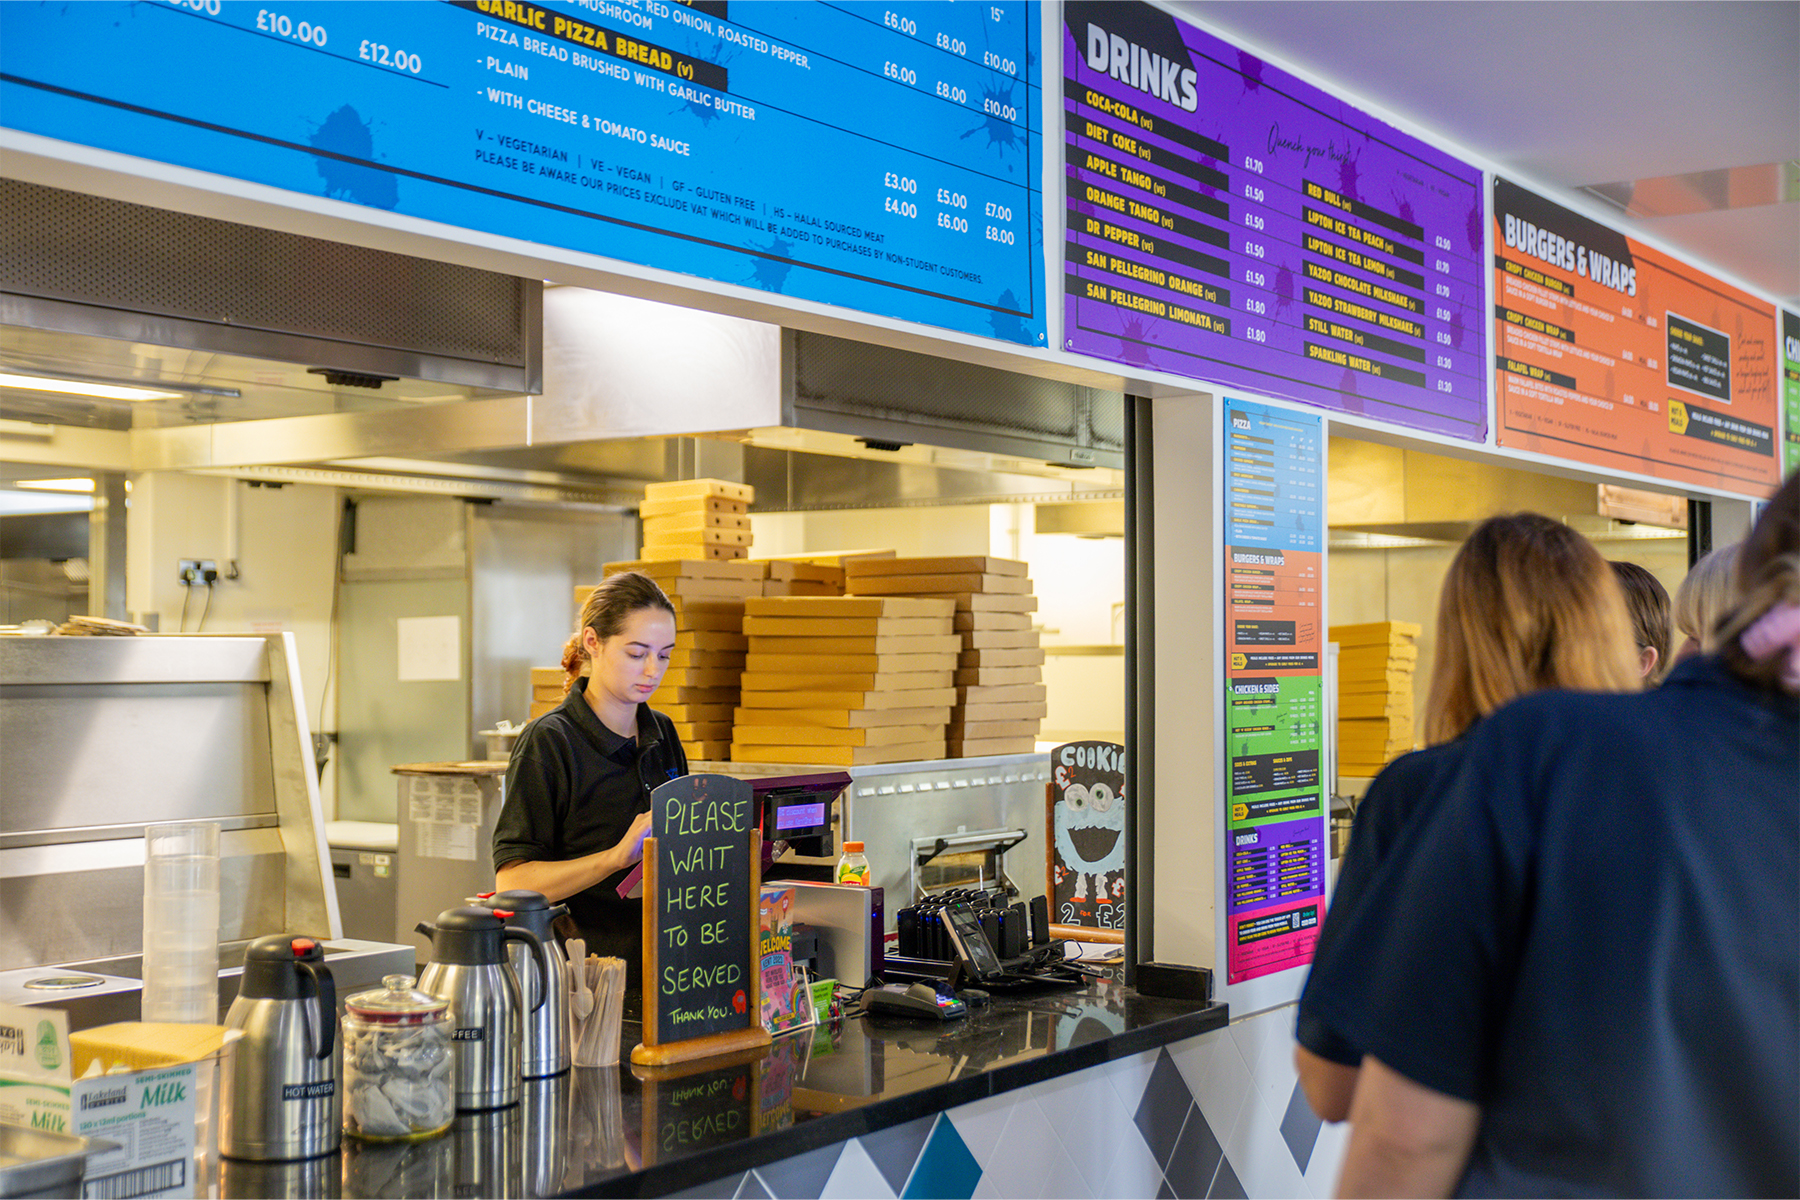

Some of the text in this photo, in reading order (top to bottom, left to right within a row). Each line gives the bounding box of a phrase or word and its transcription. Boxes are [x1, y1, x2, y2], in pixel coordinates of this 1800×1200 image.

[256, 9, 327, 47] £10.00
[579, 0, 652, 30] MUSHROOM
[476, 0, 546, 30] GARLIC
[554, 16, 608, 51] PIZZA
[616, 37, 672, 71] BREAD
[646, 1, 669, 19] RED
[672, 9, 715, 36] ONION,
[718, 25, 769, 54] ROASTED
[771, 44, 811, 70] PEPPER,
[884, 10, 1016, 75] £6.00 £8.00 £10.00
[358, 39, 422, 74] £12.00
[477, 22, 755, 120] PIZZA BREAD BRUSHED WITH GARLIC BUTTER
[487, 56, 529, 81] PLAIN
[1087, 22, 1198, 113] DRINKS
[884, 61, 1017, 122] £6.00 £8.00 £10.00
[487, 87, 690, 156] WITH CHEESE & TOMATO SAUCE
[1086, 91, 1138, 124] COCA-COLA
[1086, 122, 1136, 154] DIET COKE
[1086, 155, 1151, 190] APPLE TANGO
[1245, 157, 1263, 175] £1.70
[497, 134, 885, 244] VEGETARIAN VE VEGAN GF GLUTEN FREE HS HALAL SOURCED MEAT
[884, 172, 1012, 222] £3.00 £5.00 £7.00
[1245, 185, 1264, 203] £1.50
[1308, 183, 1322, 198] RED
[1324, 189, 1341, 206] BULL
[475, 149, 983, 285] PLEASE BE AWARE OUR PRICES EXCLUDE VAT WHICH WILL BE ADDED TO PURCHASES BY NON-STUDENT CUSTOMERS.
[1086, 187, 1159, 223] ORANGE TANGO
[884, 197, 1015, 246] £4.00 £6.00 £8.00
[1087, 219, 1139, 247] DR PEPPER
[1246, 213, 1264, 230] £1.50
[1308, 210, 1333, 230] LIPTON
[1335, 219, 1346, 235] ICE
[1348, 225, 1361, 241] TEA
[1363, 231, 1384, 250] PEACH
[1246, 242, 1264, 258] £1.50
[1308, 237, 1333, 256] LIPTON
[1335, 246, 1346, 261] ICE
[1348, 252, 1361, 266] TEA
[1364, 257, 1385, 275] LEMON
[1505, 213, 1636, 297] BURGERS & WRAPS
[1087, 251, 1203, 297] SAN PELLEGRINO ORANGE
[1246, 270, 1265, 286] £1.50
[1308, 264, 1331, 282] YAZOO
[1334, 273, 1371, 295] CHOCOLATE
[1373, 287, 1408, 308] MILKSHAKE
[1087, 284, 1211, 329] SAN PELLEGRINO LIMONATA
[1246, 299, 1265, 314] £1.80
[1309, 291, 1332, 308] YAZOO
[1334, 300, 1377, 323] STRAWBERRY
[1379, 315, 1413, 334] MILKSHAKE
[1247, 327, 1266, 342] £1.80
[1309, 318, 1328, 334] STILL
[1331, 325, 1353, 341] WATER
[1546, 322, 1560, 336] WRAP
[1310, 345, 1347, 365] SPARKLING
[1349, 356, 1371, 372] WATER
[1508, 360, 1544, 379] FALAFEL WRAP
[1233, 418, 1251, 430] PIZZA
[1234, 553, 1285, 566] BURGERS WRAPS
[1235, 684, 1279, 694] CHICKEN SIDES
[665, 798, 747, 835] PLEASE
[1236, 833, 1258, 846] DRINKS
[669, 845, 734, 875] WAIT
[667, 883, 729, 913] HERE
[1061, 902, 1081, 926] 2
[664, 920, 729, 948] TO BE
[762, 957, 773, 968] KENT
[662, 963, 740, 995] SERVED
[668, 1006, 706, 1025] THANK
[135, 1068, 191, 1084] SEMI-SKIMMED
[285, 1083, 334, 1097] HOT WATER
[26, 1098, 70, 1111] SEMI-SKIMMED
[88, 1086, 127, 1100] Lakeland
[140, 1081, 186, 1109] Milk
[31, 1110, 66, 1133] Milk
[116, 1111, 146, 1124] portions
